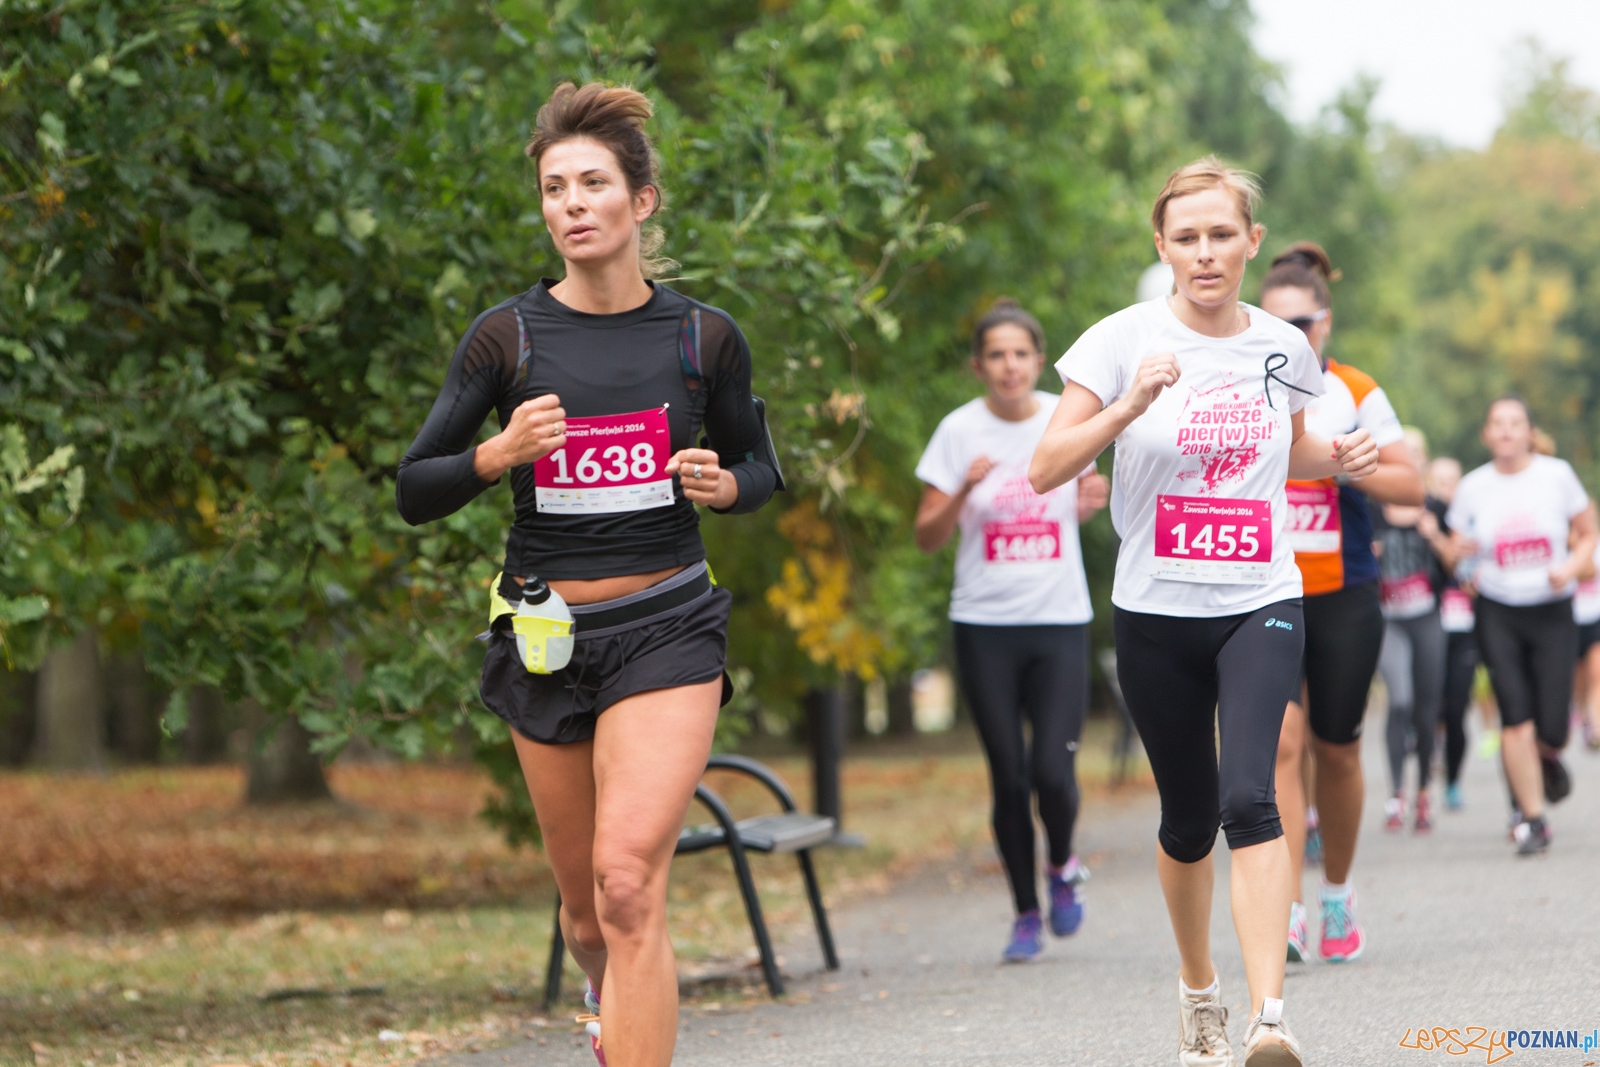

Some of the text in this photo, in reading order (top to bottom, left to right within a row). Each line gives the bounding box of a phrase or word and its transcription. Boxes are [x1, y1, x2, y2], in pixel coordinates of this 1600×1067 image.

[1190, 409, 1262, 424] zawsze
[563, 429, 589, 437] awsze
[590, 425, 624, 437] Pier(w)si
[624, 422, 646, 433] 2016
[1181, 443, 1212, 455] 2016
[549, 442, 657, 484] 1638
[1182, 505, 1208, 514] Zawsze
[1209, 506, 1236, 516] Pier(w)si
[1236, 507, 1254, 516] 2016
[1170, 522, 1260, 558] 1455
